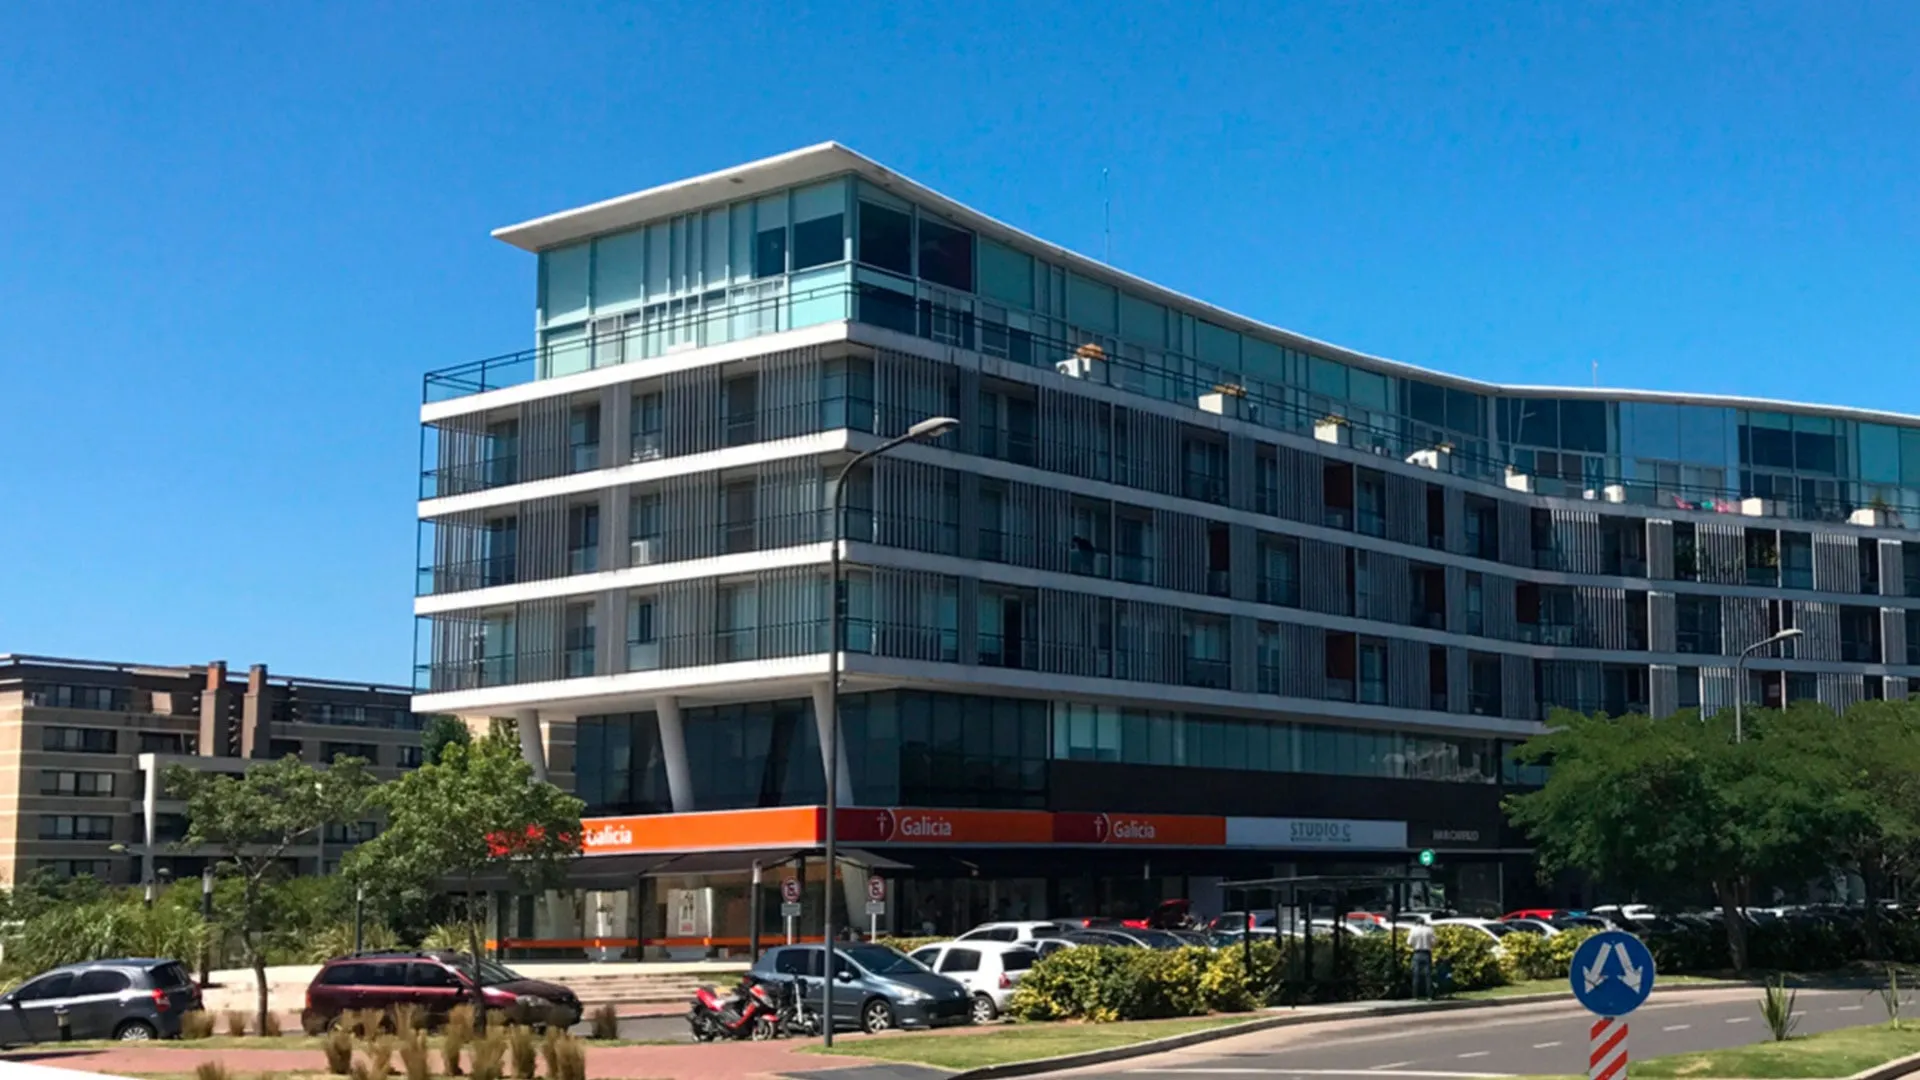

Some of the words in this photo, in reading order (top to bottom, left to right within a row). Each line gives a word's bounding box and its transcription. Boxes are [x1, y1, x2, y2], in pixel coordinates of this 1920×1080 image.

[901, 816, 953, 836] Galicia
[1113, 820, 1156, 838] Galicia
[1290, 821, 1339, 837] STUDIO
[1342, 823, 1351, 837] C
